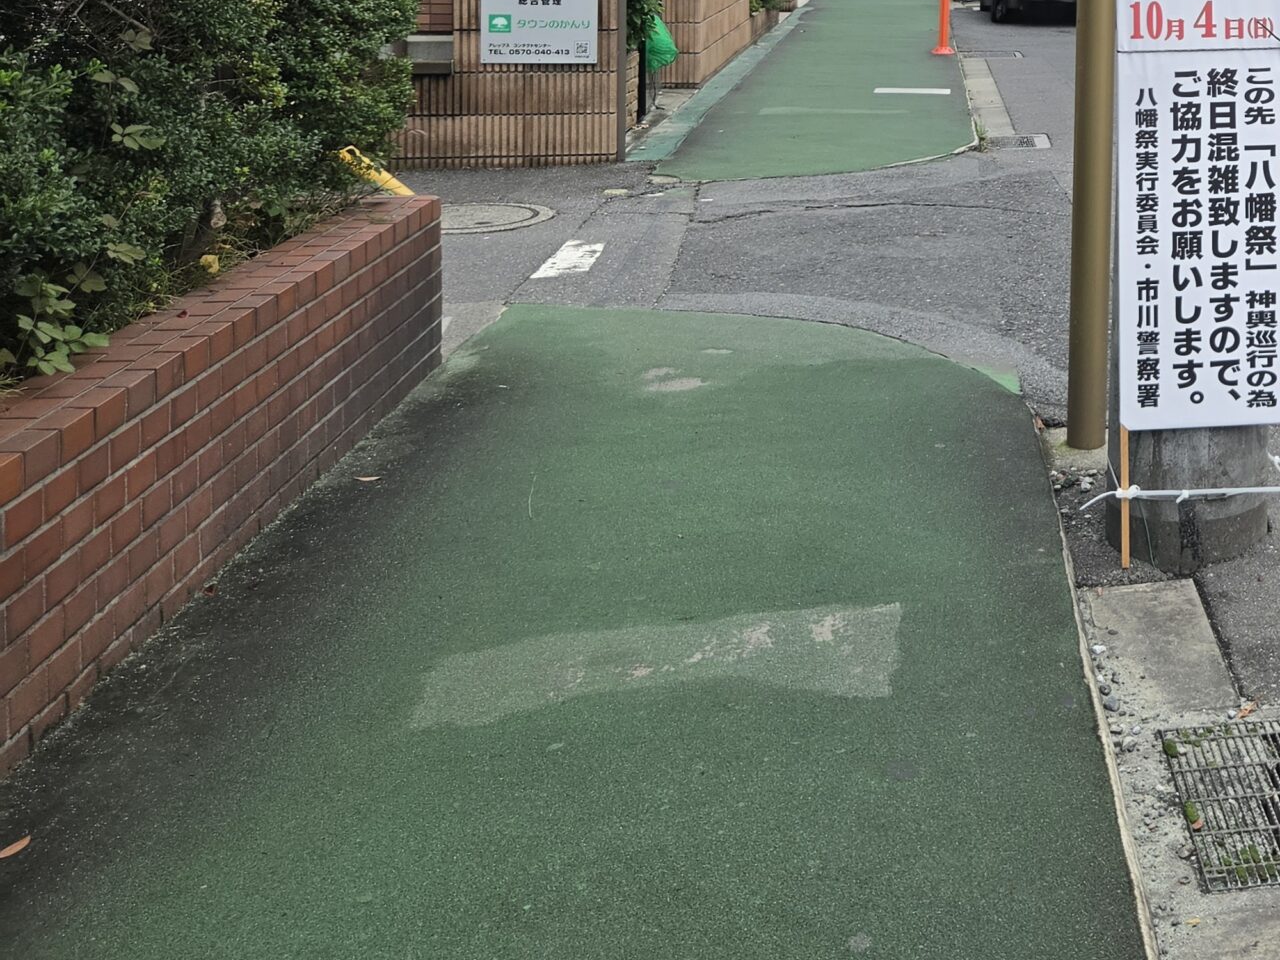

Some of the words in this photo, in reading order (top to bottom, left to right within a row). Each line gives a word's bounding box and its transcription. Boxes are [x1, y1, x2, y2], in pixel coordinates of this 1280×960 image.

[516, 19, 590, 29] タウンのかんり
[1244, 67, 1276, 125] この先
[1134, 87, 1160, 408] 八幡祭実行委員会・市川警察署
[1170, 69, 1204, 405] ご協力をお願いします。
[1206, 67, 1241, 402] 終日混雑致しますので、
[1244, 143, 1277, 272] 「八幡祭」
[1245, 289, 1278, 408] 神輿巡行の為
